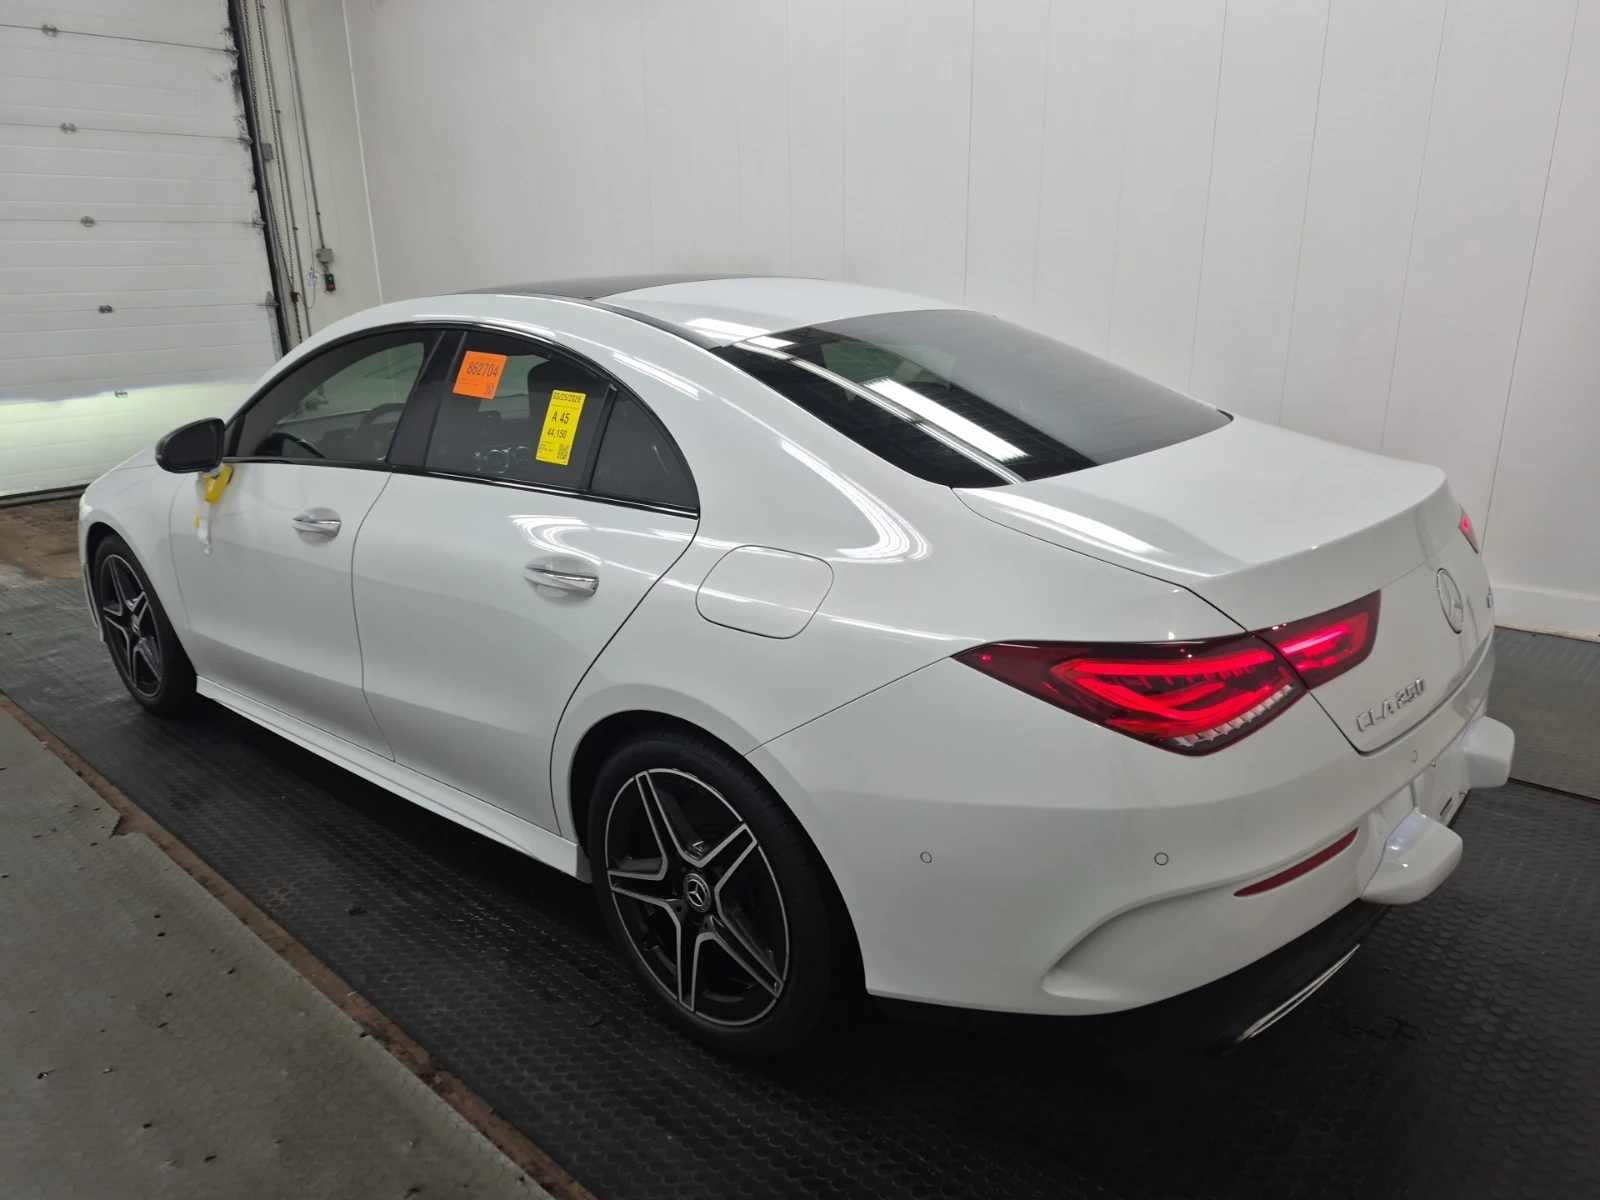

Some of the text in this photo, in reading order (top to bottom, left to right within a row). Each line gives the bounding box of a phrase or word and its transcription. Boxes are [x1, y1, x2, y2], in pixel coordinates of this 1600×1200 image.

[467, 361, 499, 378] 862704
[551, 411, 571, 424] A 45
[547, 427, 567, 439] 44,150
[1356, 676, 1425, 732] CLA 250
